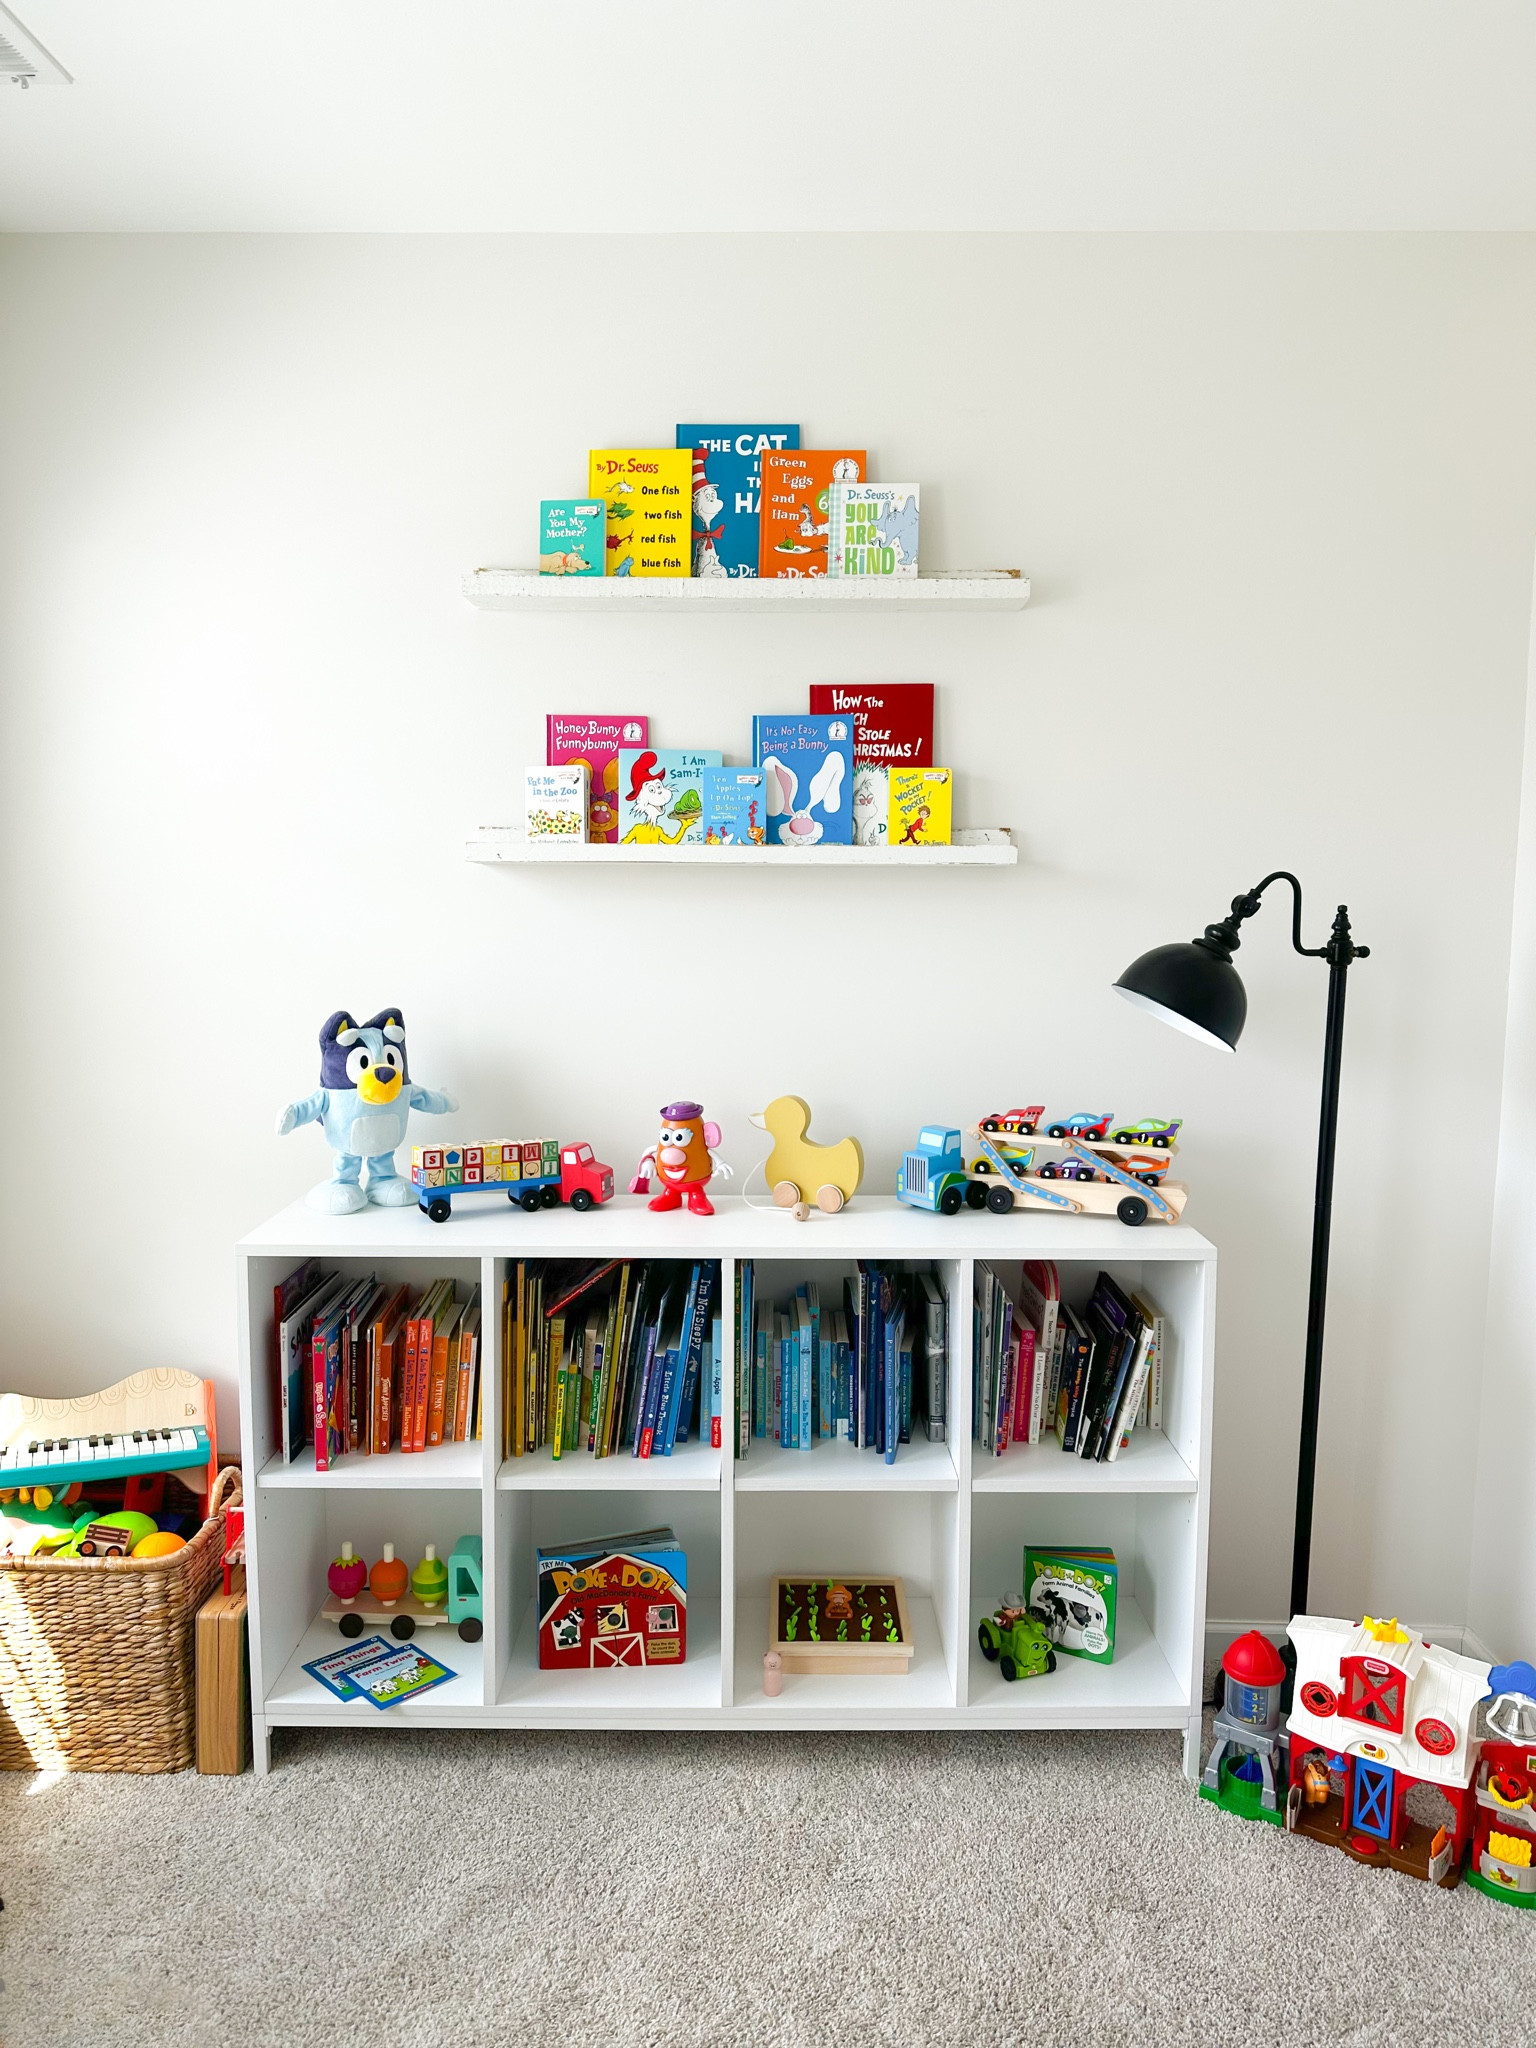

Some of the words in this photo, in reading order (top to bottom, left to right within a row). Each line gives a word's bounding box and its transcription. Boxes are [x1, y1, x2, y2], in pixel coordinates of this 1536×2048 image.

[699, 440, 731, 452] THE
[735, 434, 788, 456] CAT
[606, 460, 626, 475] Dr.
[627, 458, 659, 474] Seuss
[769, 456, 807, 468] Green
[782, 474, 814, 490] Eggs
[642, 486, 659, 495] One
[662, 486, 680, 495] fish
[847, 490, 862, 500] Dr.
[865, 489, 895, 500] Seuss's
[772, 494, 795, 504] and
[818, 496, 829, 509] 6
[548, 508, 566, 518] Are
[644, 511, 662, 519] two
[664, 509, 682, 519] fish
[772, 509, 800, 520] Ham
[549, 519, 566, 528] You
[569, 518, 585, 528] My
[546, 527, 587, 538] Mother?
[641, 535, 656, 544] red
[658, 534, 676, 544] fish
[642, 559, 661, 568] blue
[663, 558, 681, 568] fish
[738, 564, 757, 577] Dr.
[787, 567, 806, 578] Dr
[556, 720, 588, 736] Honey
[588, 721, 621, 738] Bunny
[766, 727, 778, 737] It's
[781, 725, 796, 736] Not
[798, 724, 819, 737] Easy
[556, 736, 619, 752] Funnybunny
[762, 741, 788, 754] Being
[798, 737, 829, 753] Bunny
[853, 737, 922, 757] HRISTMAS!
[682, 756, 687, 766] I
[690, 757, 706, 766] Am
[670, 768, 703, 780] Sam-I-
[533, 787, 542, 796] in
[544, 788, 559, 797] the
[560, 787, 578, 795] Zoo
[895, 782, 924, 802] WOCKET
[1072, 1127, 1079, 1135] 6
[1141, 1134, 1146, 1142] 1
[1064, 1169, 1069, 1178] 3
[700, 1279, 711, 1295] I'm
[696, 1298, 708, 1315] Not
[691, 1317, 704, 1350] Sleepy
[663, 1371, 673, 1393] Little
[434, 1378, 444, 1409] AUTUMN
[660, 1395, 669, 1411] Blue
[656, 1412, 666, 1435] Truck
[541, 1561, 554, 1570] TRY
[320, 1660, 346, 1672] Tiny
[346, 1645, 382, 1662] Things
[354, 1665, 383, 1679] Farm
[382, 1653, 414, 1667] Twins
[1252, 1693, 1258, 1701] 3
[1252, 1704, 1258, 1712] 2
[1253, 1716, 1257, 1724] 1
